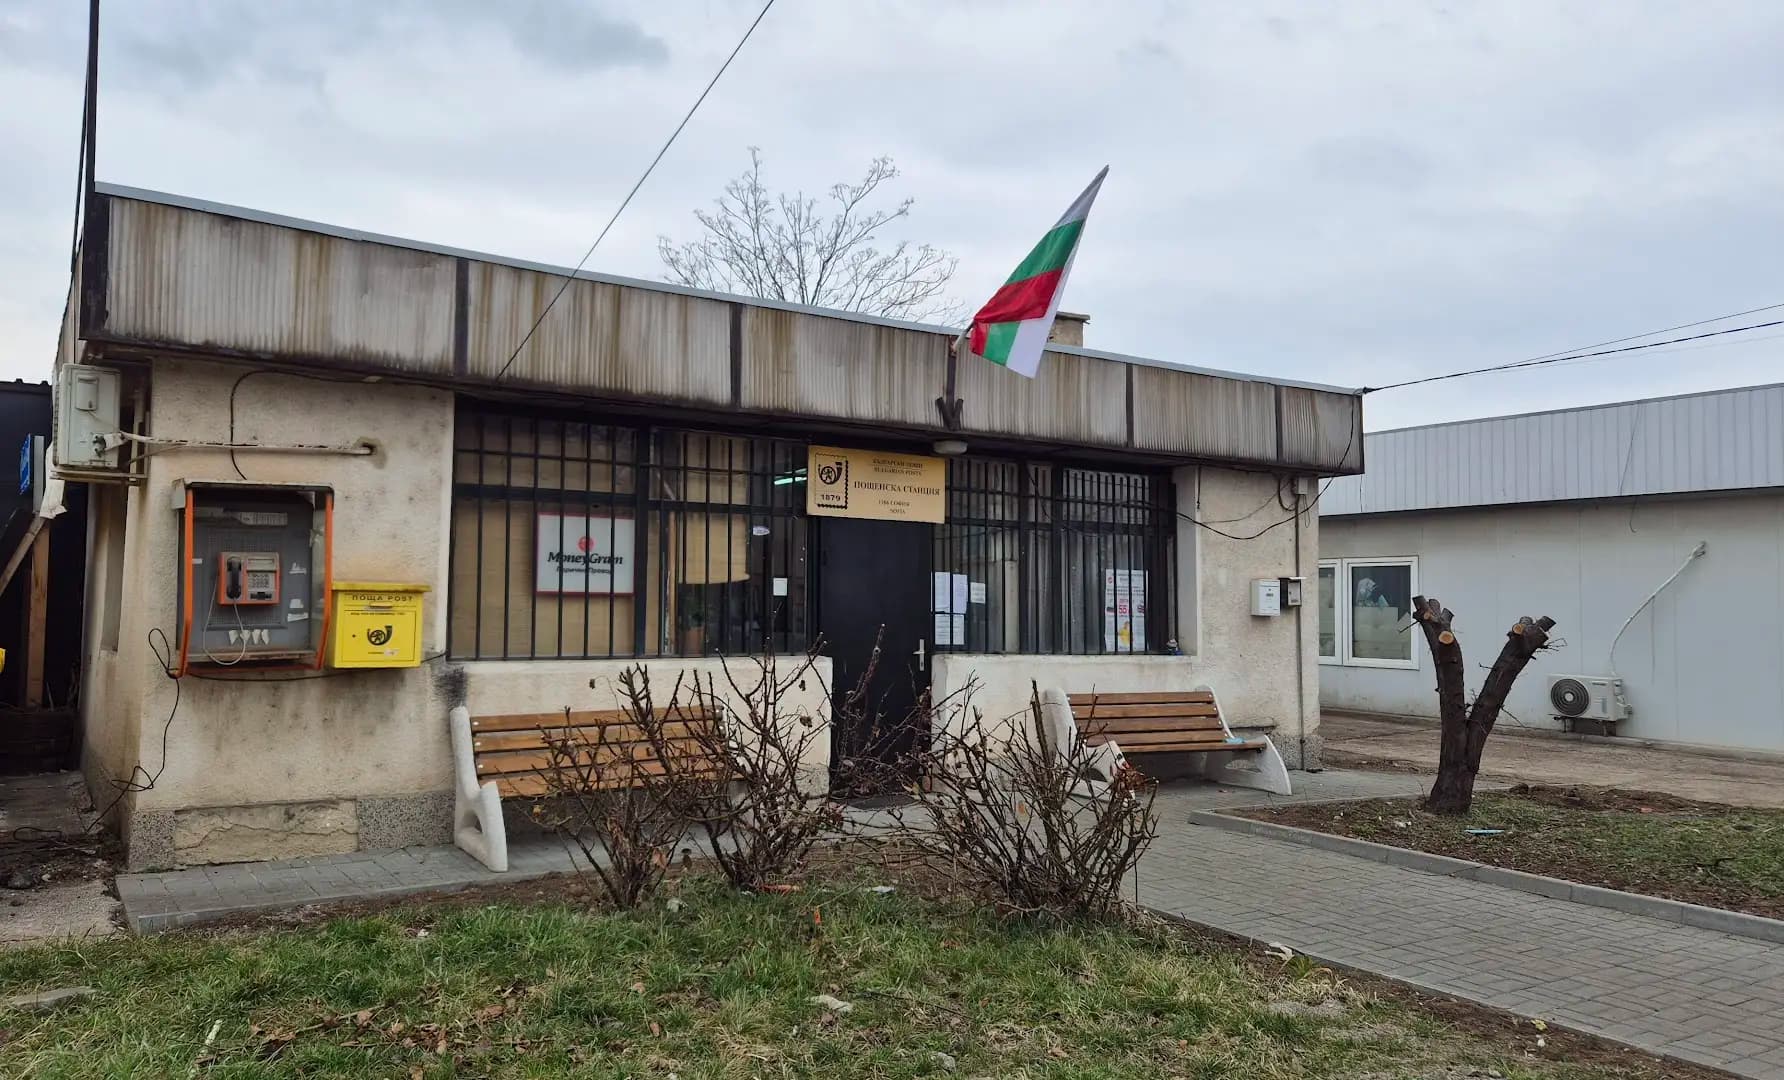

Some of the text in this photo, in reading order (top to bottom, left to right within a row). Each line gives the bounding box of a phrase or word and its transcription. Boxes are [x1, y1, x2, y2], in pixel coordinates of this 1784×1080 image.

[854, 481, 941, 496] ПОЩЕНСКА СТАНЦИЯ
[820, 494, 841, 502] 1879
[547, 552, 624, 566] MoneyGram
[352, 594, 383, 602] ПОЩА
